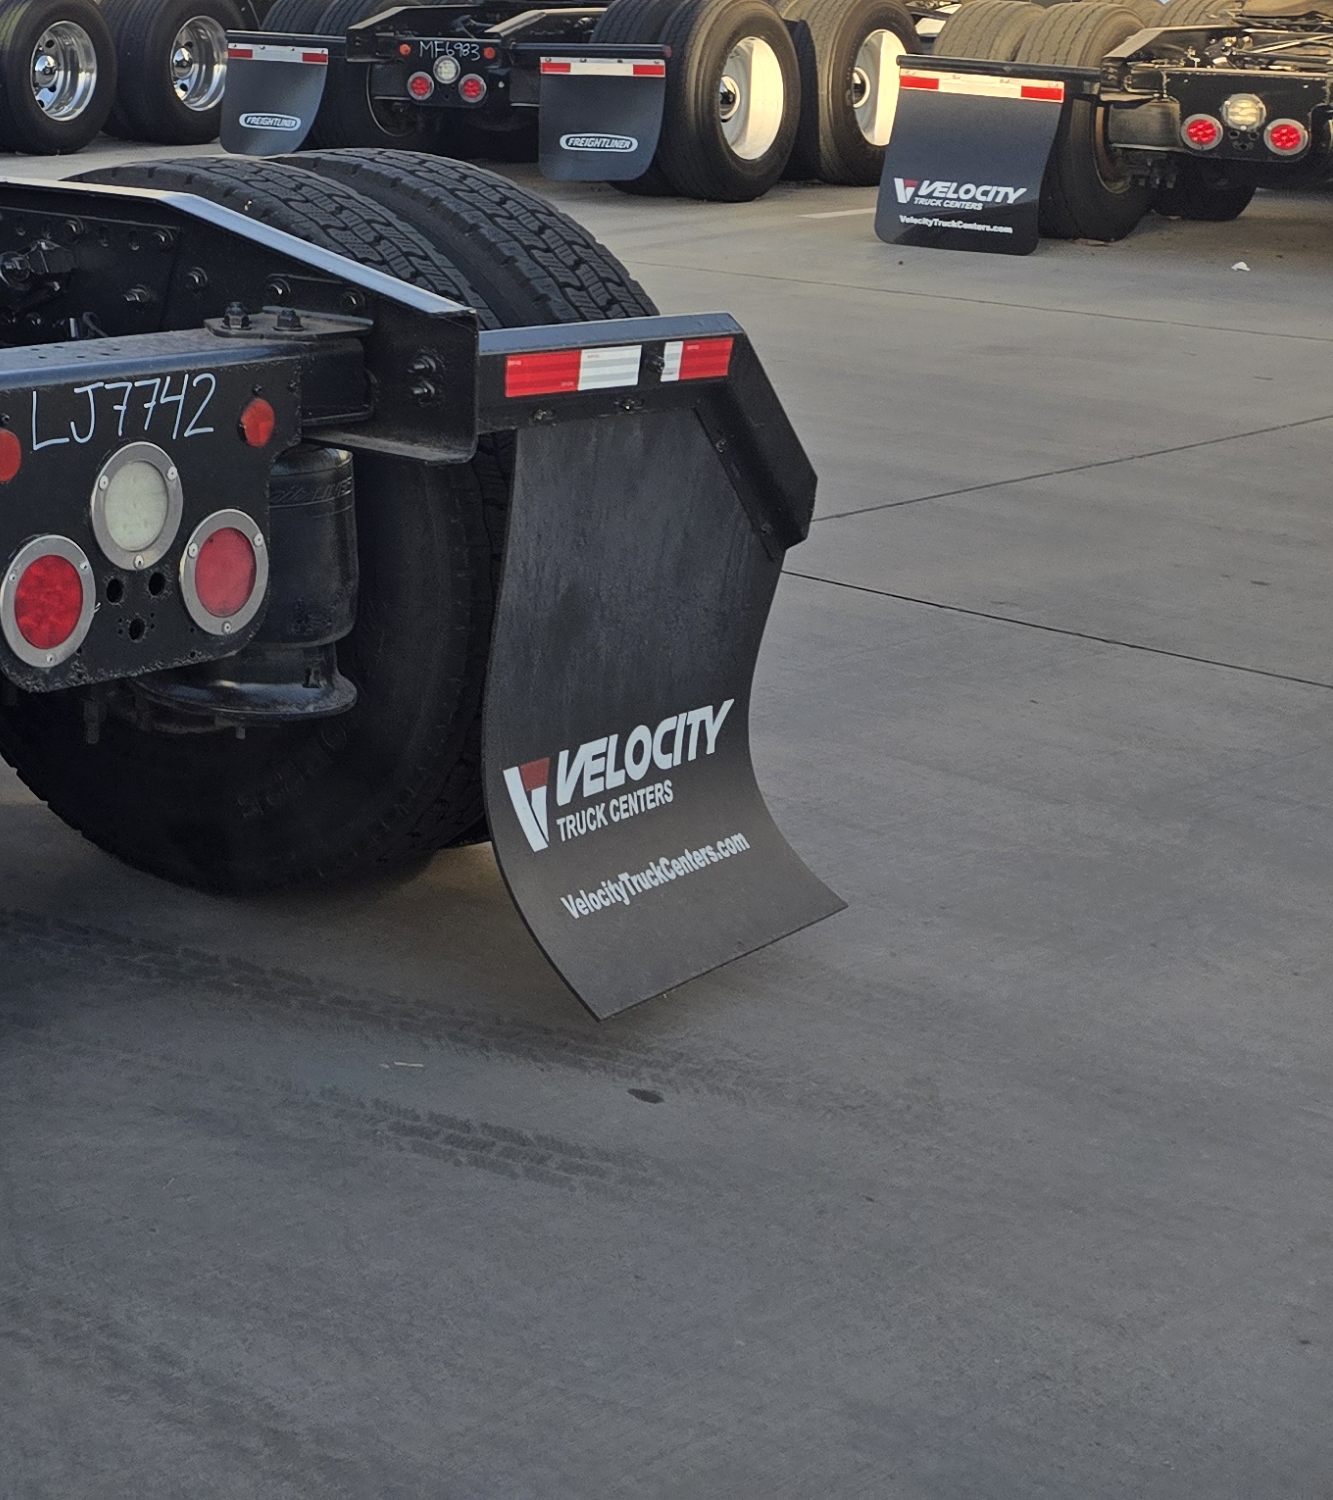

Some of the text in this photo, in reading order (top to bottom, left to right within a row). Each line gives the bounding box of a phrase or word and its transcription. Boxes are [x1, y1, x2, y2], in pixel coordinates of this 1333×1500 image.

[419, 40, 481, 62] MF6983
[245, 116, 297, 128] FREIGHTLINER
[567, 137, 631, 149] FREIGHTLINER
[913, 196, 984, 211] TRUCK CENTERS
[917, 180, 1028, 205] VELOCITY
[898, 214, 1014, 235] VelocityTruckCenters.com
[31, 373, 217, 451] LJ7742
[556, 698, 735, 807] VELOCITY
[555, 779, 675, 842] TRUCK CENTERS
[559, 832, 751, 920] VelocityTruckCenters.com
